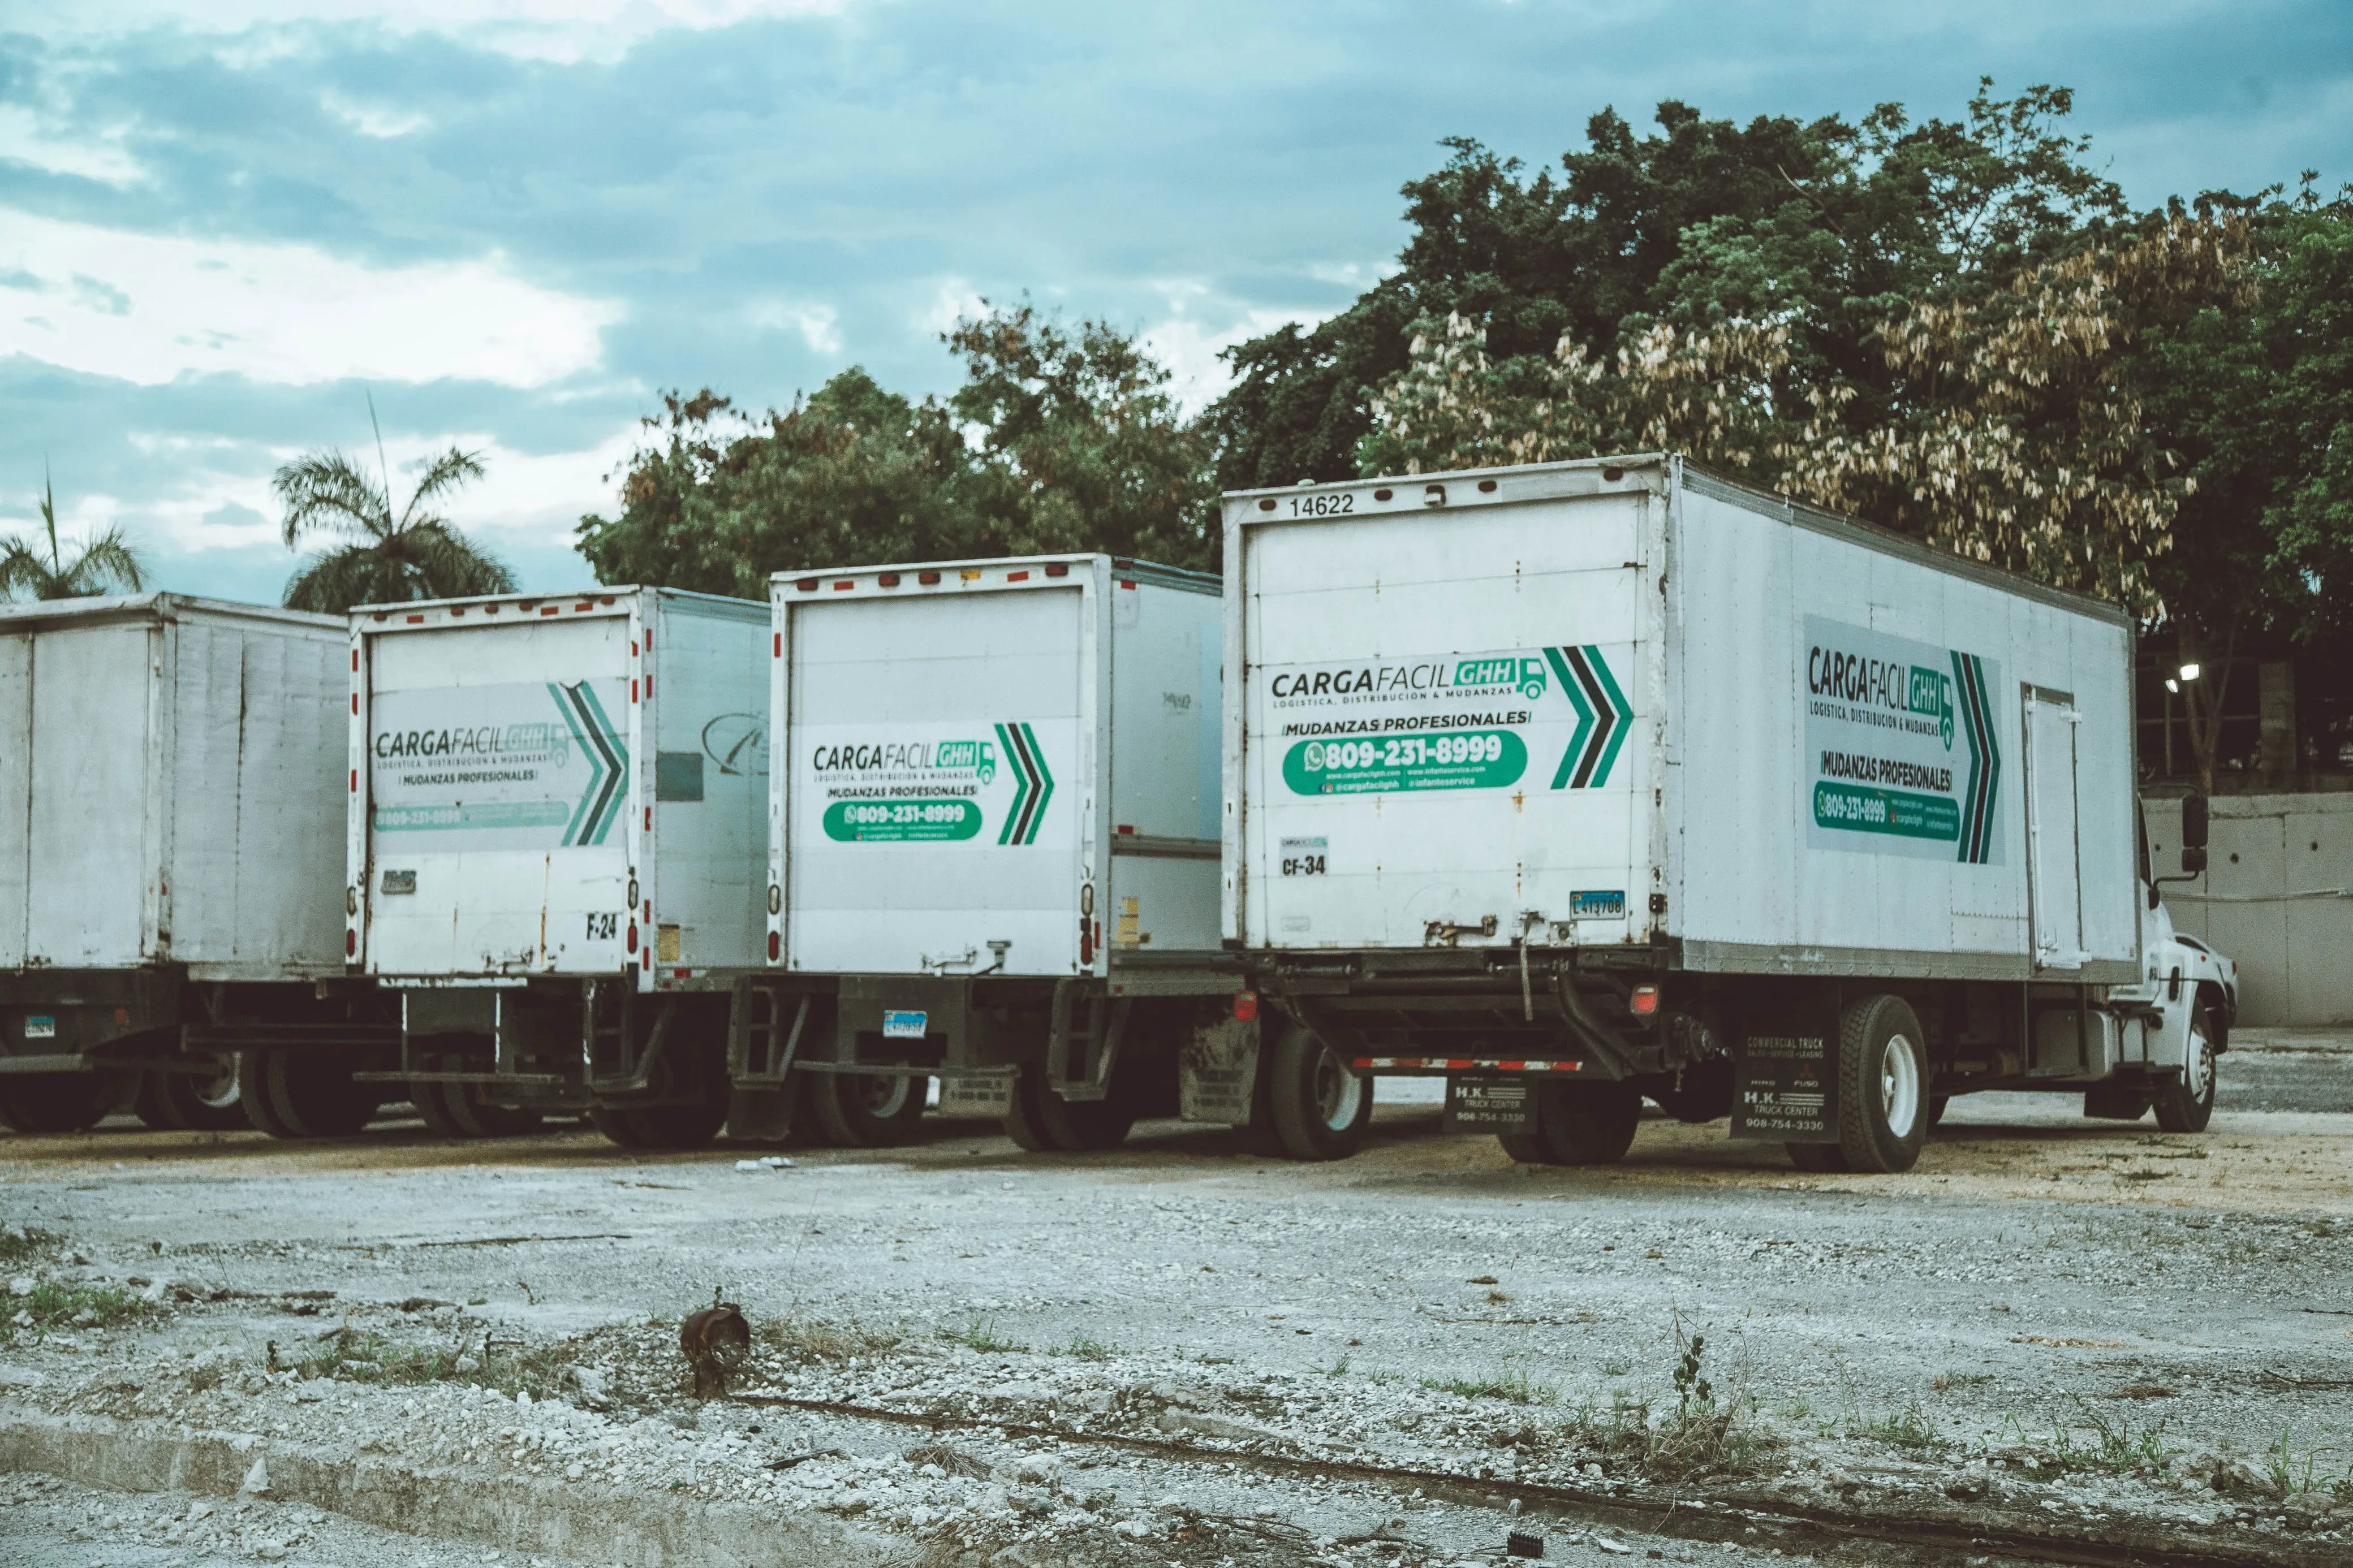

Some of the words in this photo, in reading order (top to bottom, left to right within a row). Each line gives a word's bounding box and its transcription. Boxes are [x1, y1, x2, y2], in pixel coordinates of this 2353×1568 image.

[1290, 494, 1354, 517] 14622
[1272, 663, 1450, 698] CARGAFACIL
[1459, 661, 1511, 684] GHH
[1809, 646, 1908, 711] CARGAFACIL
[1912, 673, 1937, 712] GHH
[1446, 686, 1512, 698] MUDANZAS
[1905, 719, 1939, 737] MUDANZAS
[377, 726, 504, 758] CARGAFACIL
[1325, 734, 1502, 770] 809-231-8999
[813, 742, 933, 770] CARGAFACIL
[938, 742, 973, 766] GHH
[856, 804, 965, 823] 809-231-8999
[1826, 792, 1886, 823] 809-231-8999
[1283, 855, 1325, 875] CF-34
[1799, 1038, 1824, 1049] TRUCK
[1755, 1104, 1782, 1115] TRUCK
[1785, 1105, 1818, 1117] CENTER
[1746, 1117, 1824, 1131] 908-754-3330
